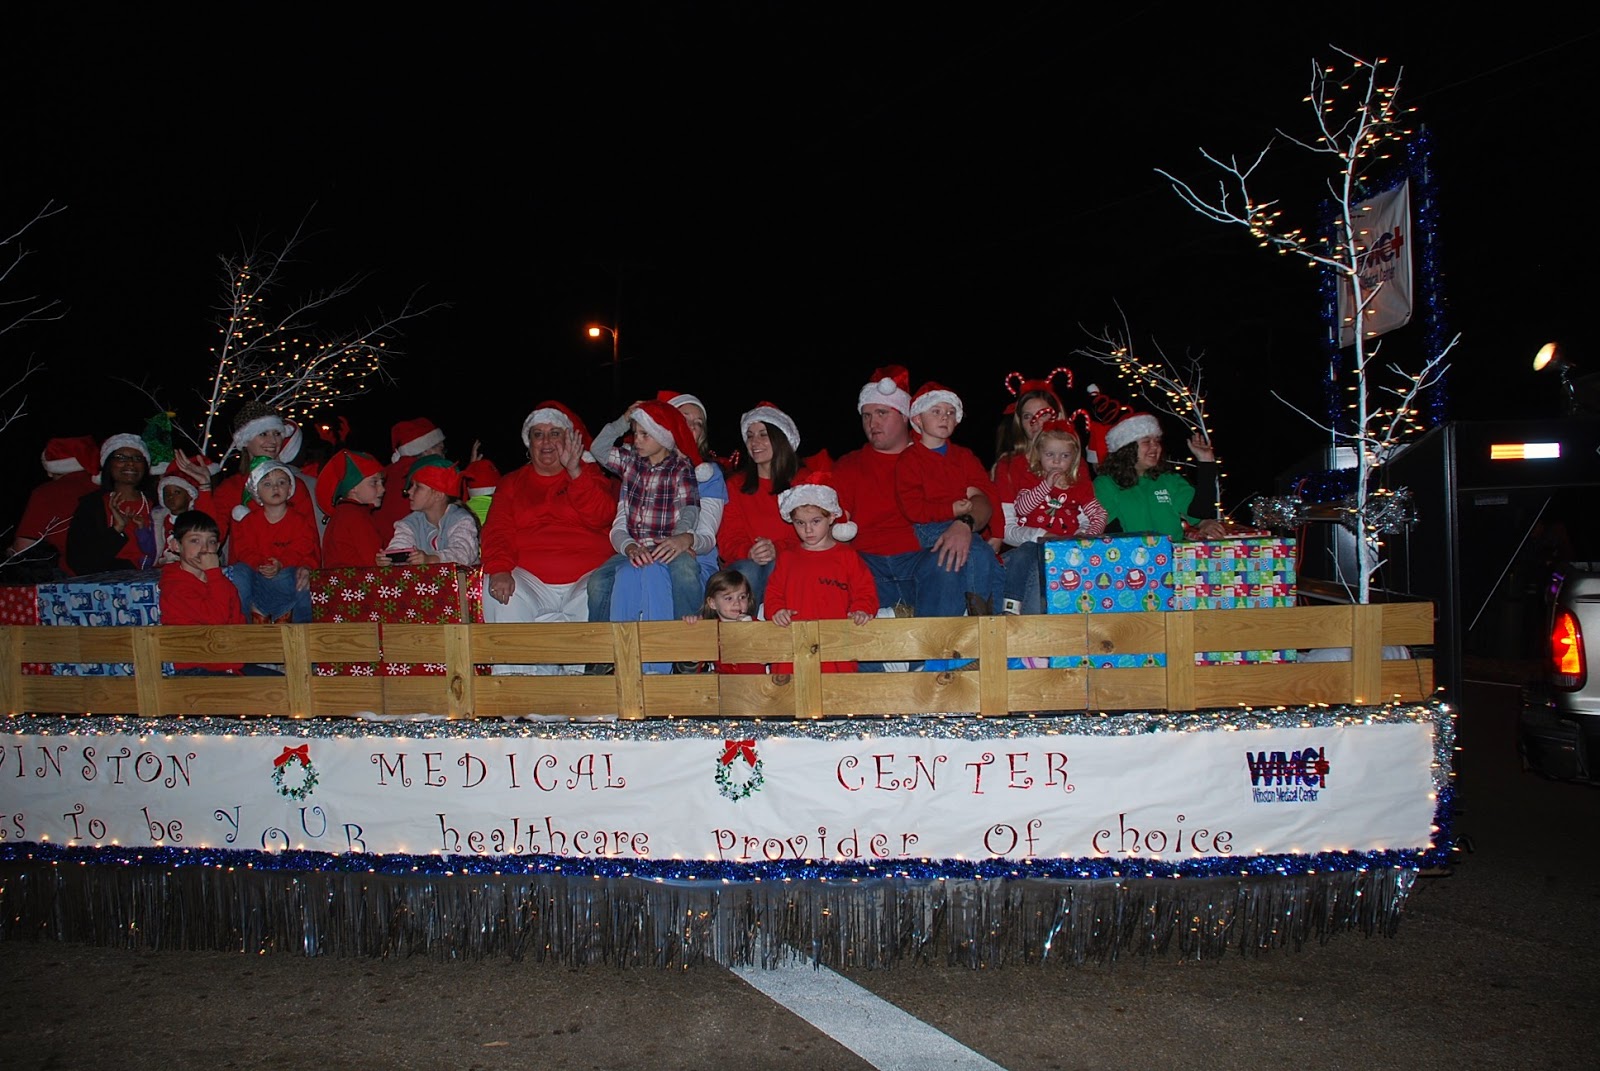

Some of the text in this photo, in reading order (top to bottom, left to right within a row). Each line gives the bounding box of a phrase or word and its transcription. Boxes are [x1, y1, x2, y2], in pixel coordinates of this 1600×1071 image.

[370, 752, 627, 791] MEDICAL
[836, 751, 1076, 794] CENTER
[1299, 787, 1319, 802] Center
[64, 803, 107, 841] To
[140, 805, 183, 842] be
[437, 812, 651, 855] healthcare
[983, 818, 1043, 857] Of
[1092, 813, 1234, 856] choice
